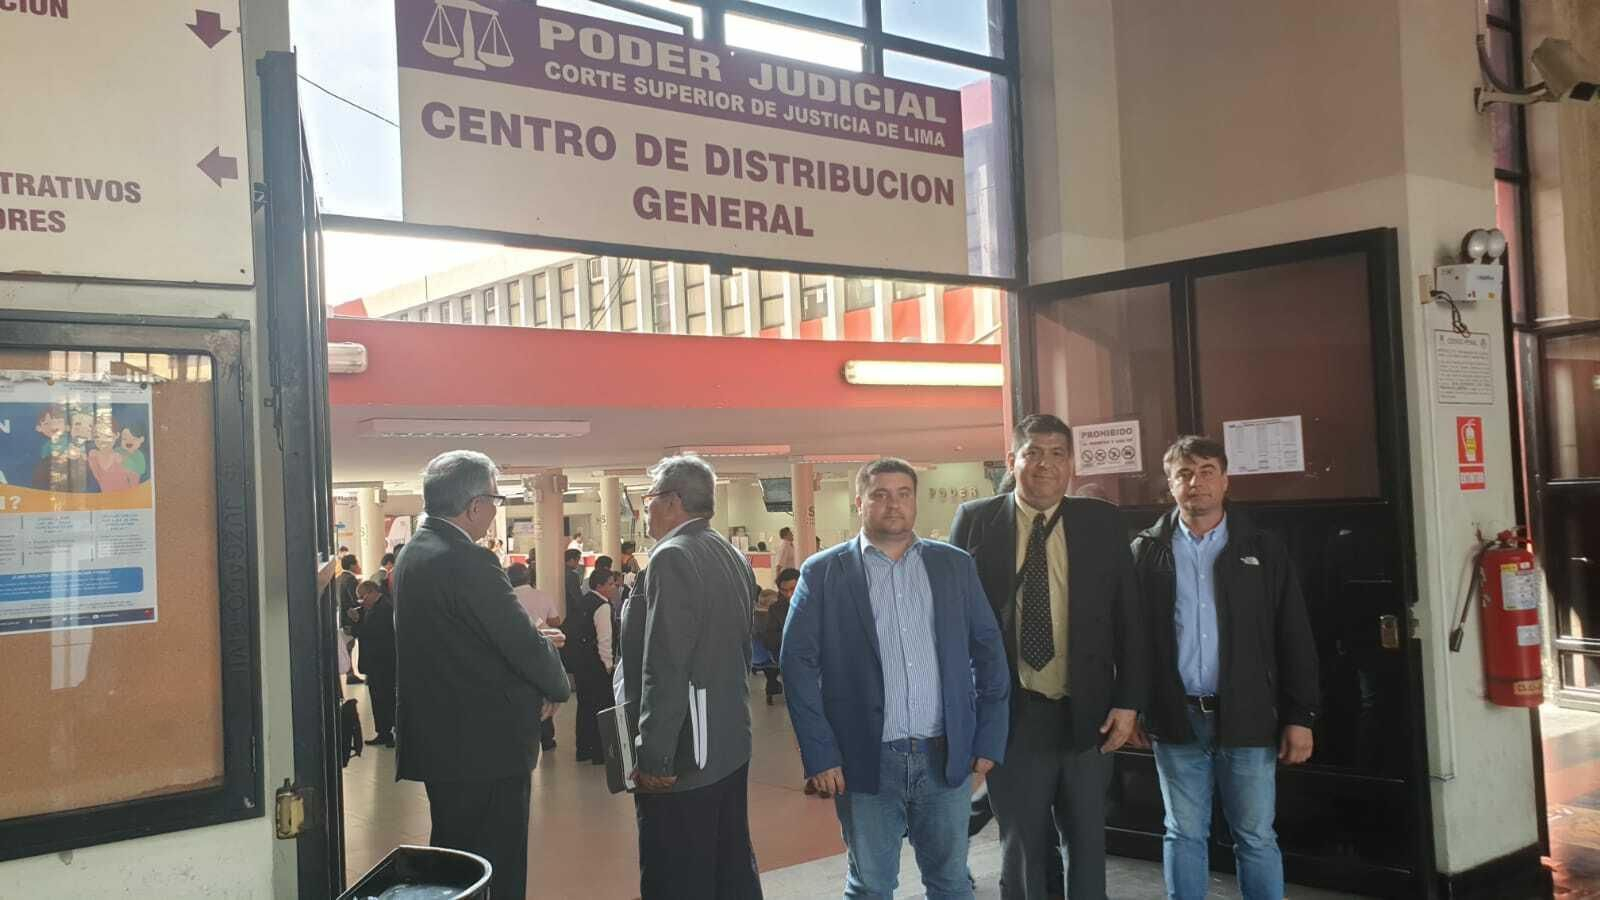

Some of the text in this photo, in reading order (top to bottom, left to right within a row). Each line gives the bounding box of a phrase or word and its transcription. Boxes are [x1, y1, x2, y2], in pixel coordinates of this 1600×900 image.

[539, 18, 947, 124] PODER JUDICIAL
[544, 62, 946, 149] CORTE SUPERIOR DE JUSTICIA DE LIMA
[421, 101, 954, 207] CENTRO DE DISTRIBUCION
[634, 186, 814, 238] GENERAL
